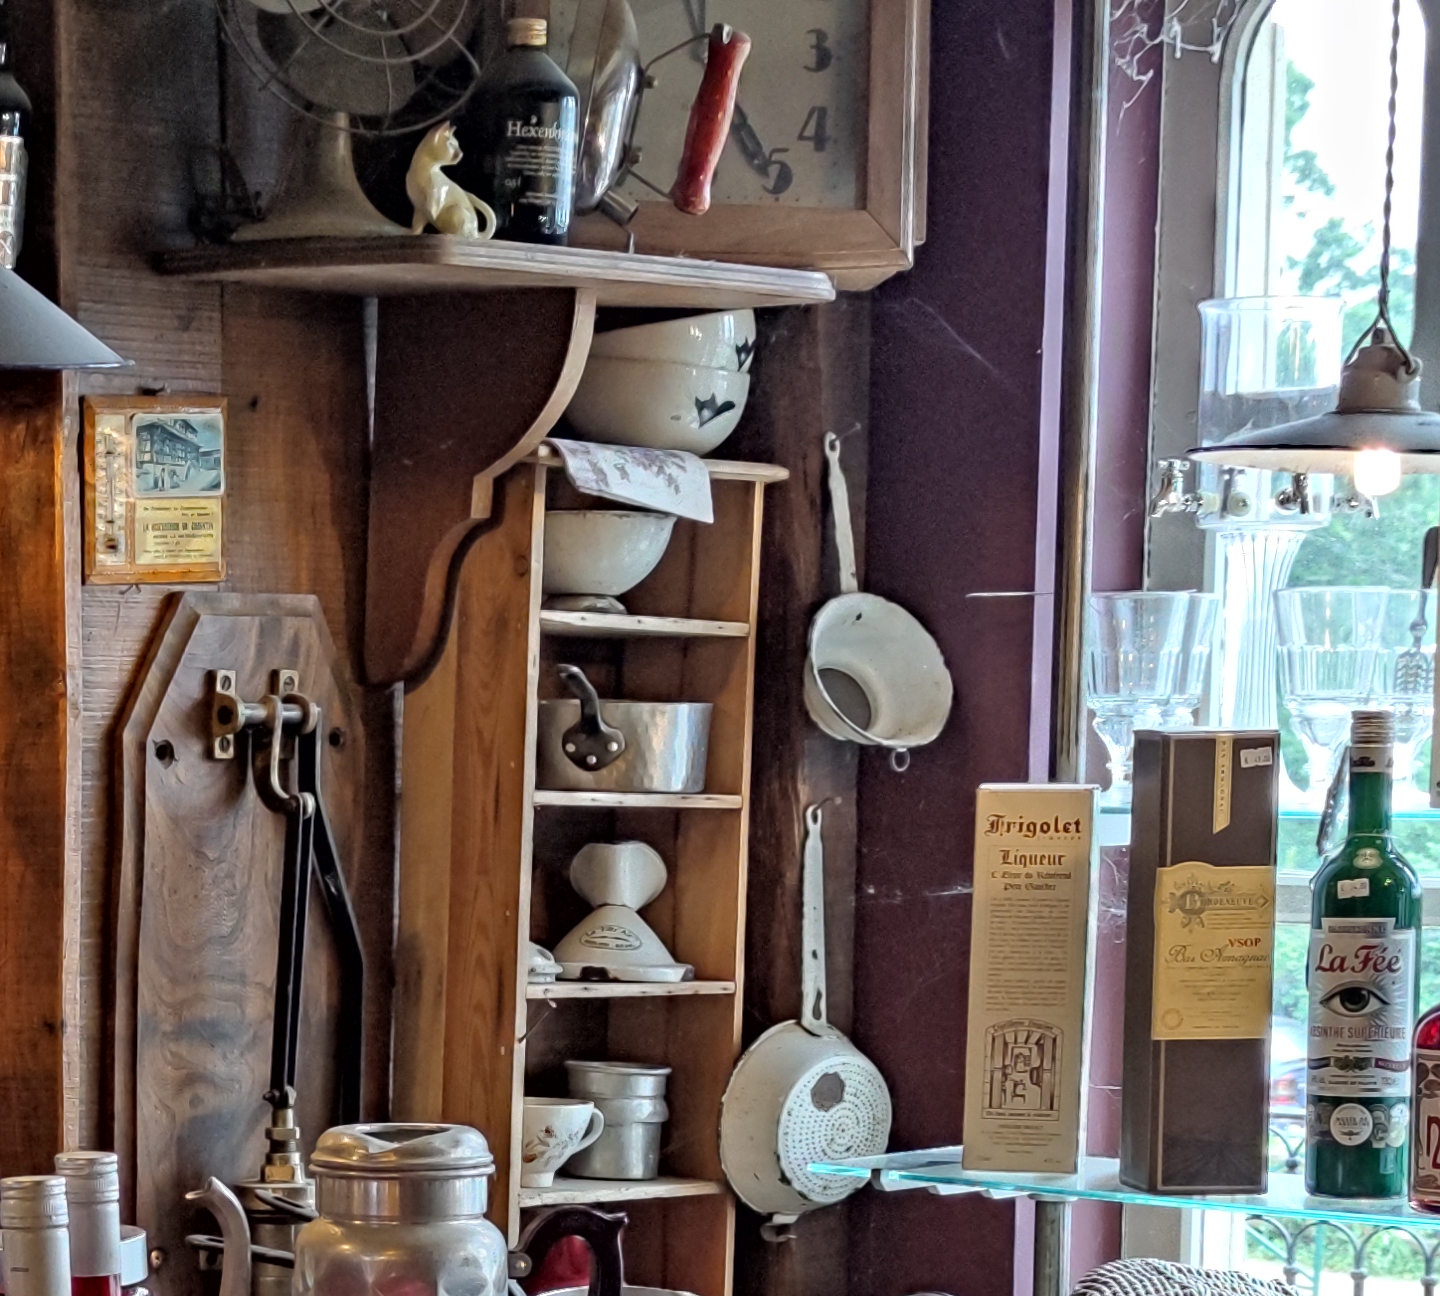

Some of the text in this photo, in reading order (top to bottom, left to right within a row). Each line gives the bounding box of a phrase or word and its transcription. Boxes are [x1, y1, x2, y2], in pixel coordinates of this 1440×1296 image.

[802, 28, 833, 73] 3
[797, 106, 828, 152] 4
[762, 148, 794, 194] 5
[983, 813, 1082, 839] Frigolet
[998, 848, 1068, 869] Liqueur
[1227, 937, 1262, 948] VSOP
[1314, 943, 1403, 974] La Fée
